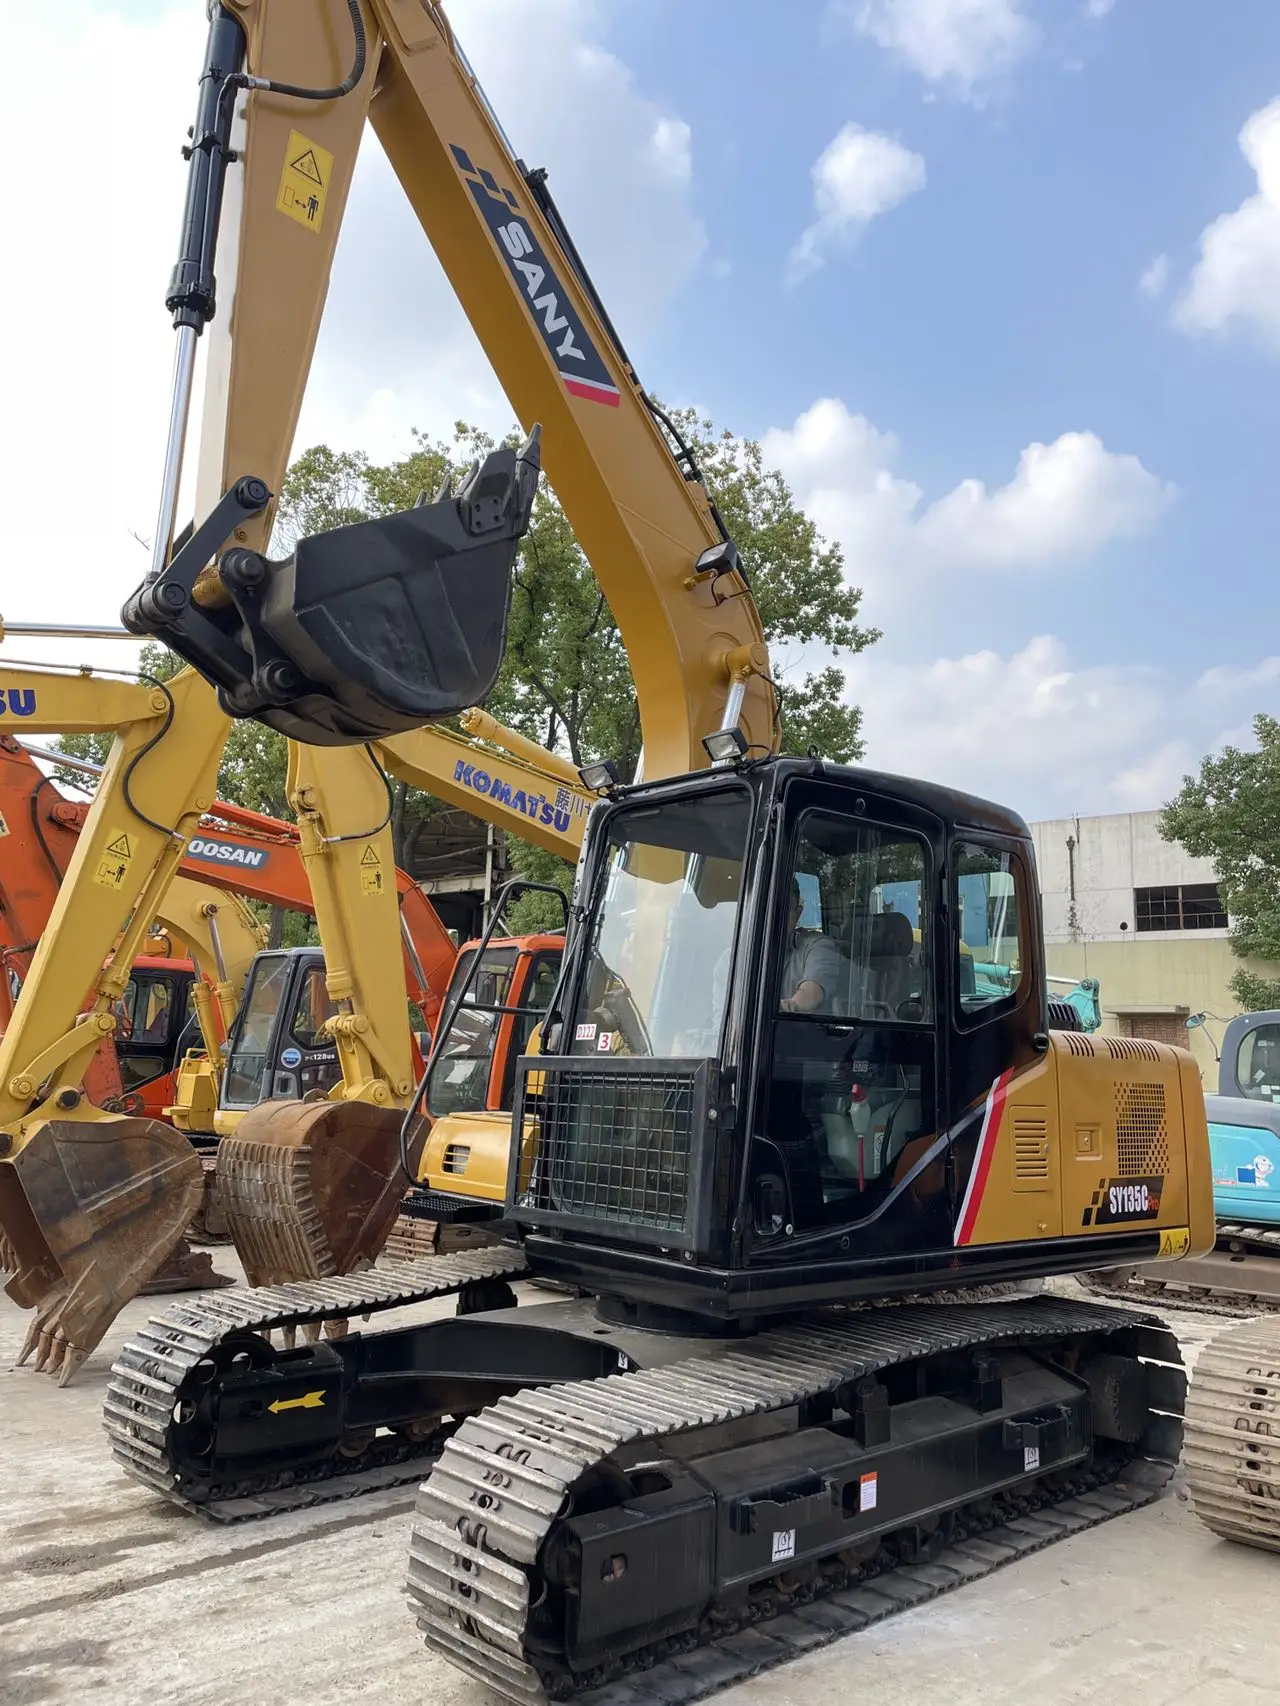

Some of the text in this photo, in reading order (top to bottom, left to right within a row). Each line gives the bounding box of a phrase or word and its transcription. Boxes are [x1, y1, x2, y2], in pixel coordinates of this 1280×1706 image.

[497, 221, 587, 361] SANY
[0, 688, 37, 717] U
[454, 759, 571, 832] KOMATSU
[600, 1034, 609, 1049] 3
[1109, 1185, 1148, 1214] SY135C
